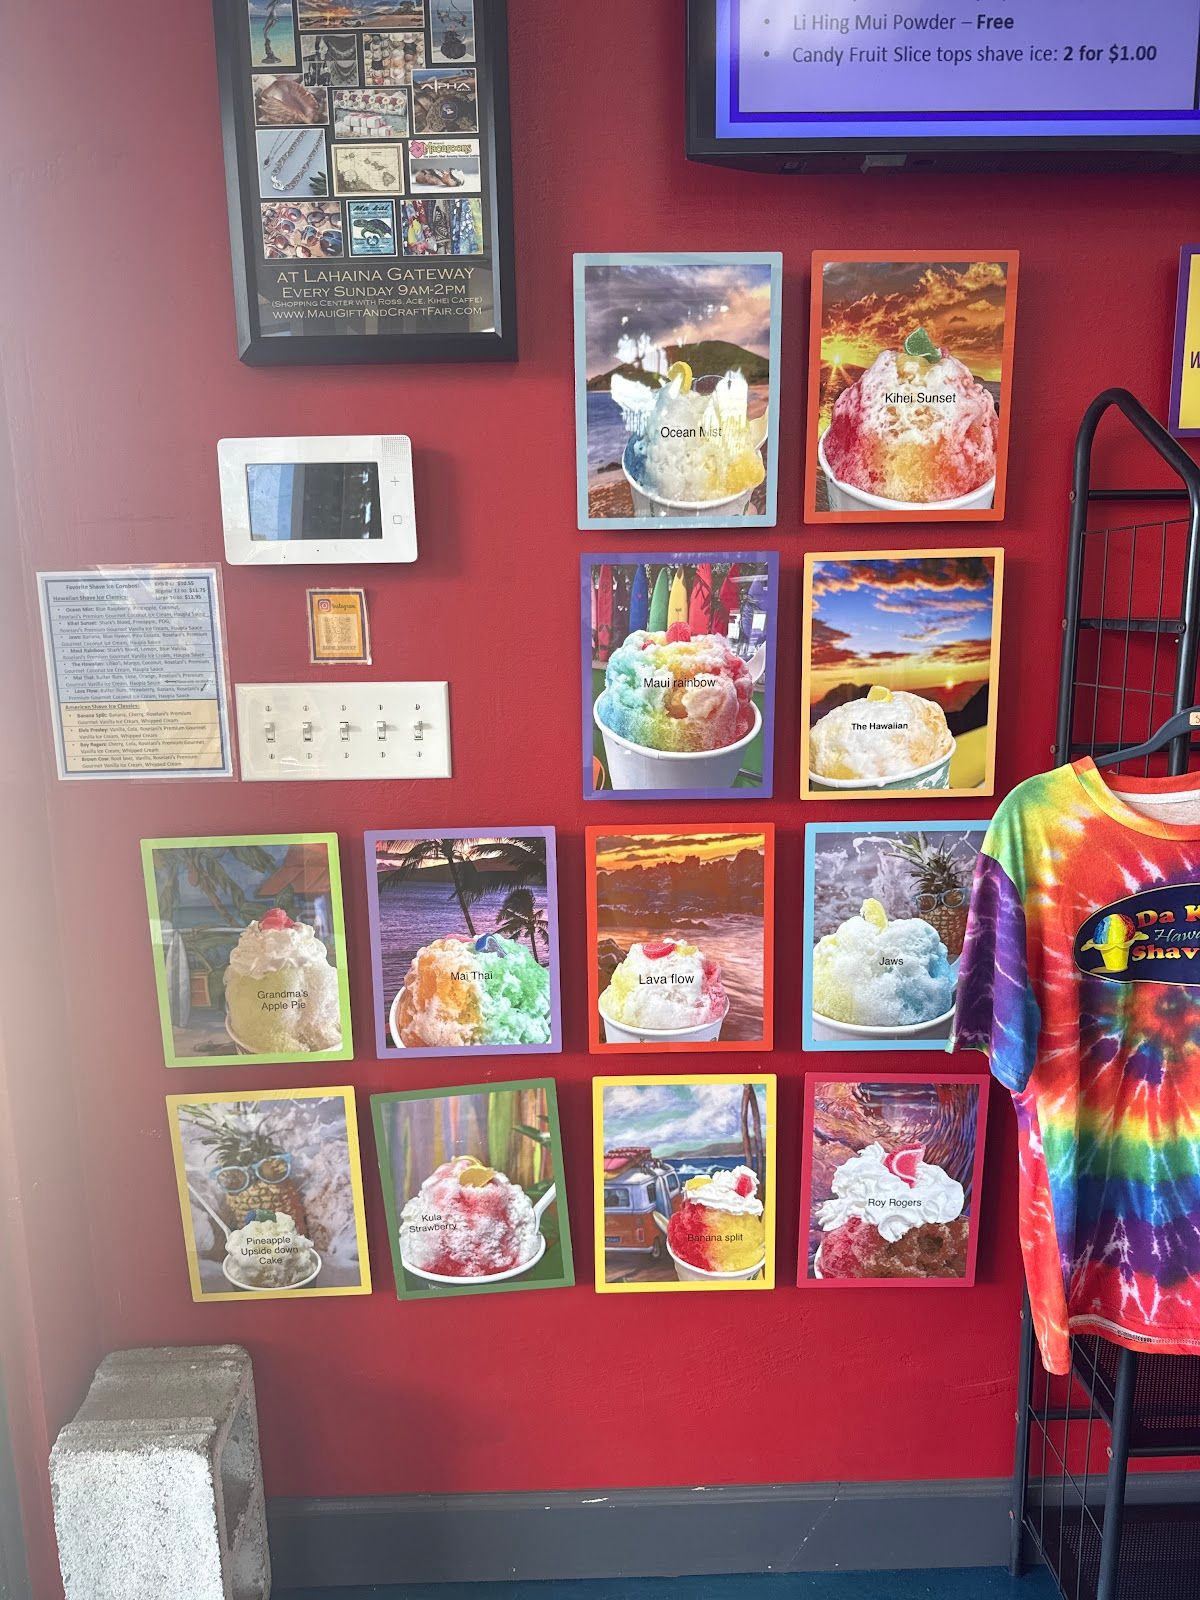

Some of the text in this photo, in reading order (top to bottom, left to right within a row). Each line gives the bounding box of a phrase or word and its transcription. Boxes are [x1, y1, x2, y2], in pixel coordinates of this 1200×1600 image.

[793, 13, 1015, 34] Li Hing Mui Powder Free
[792, 43, 1157, 66] Candy Fruit Slice tops shave ice: 2 for $1.00
[884, 391, 957, 404] Kihei Sunset
[660, 426, 722, 438] Ocean Mist
[643, 676, 716, 688] Maui rainbow
[851, 721, 908, 731] The Hawaiian
[1136, 910, 1176, 928] Da
[878, 956, 904, 966] Jaws
[450, 970, 493, 981] Mai Thai
[638, 973, 695, 985] Lava flow
[257, 989, 309, 1000] Grandma's
[261, 1000, 306, 1011] Apple Pie
[867, 1197, 922, 1209] Roy Rogers
[421, 1213, 442, 1223] Kula
[409, 1222, 457, 1234] Strawberry
[246, 1236, 292, 1248] Pineapple
[687, 1232, 744, 1244] Banana split
[240, 1246, 299, 1259] Upside down
[259, 1256, 283, 1266] Cake
